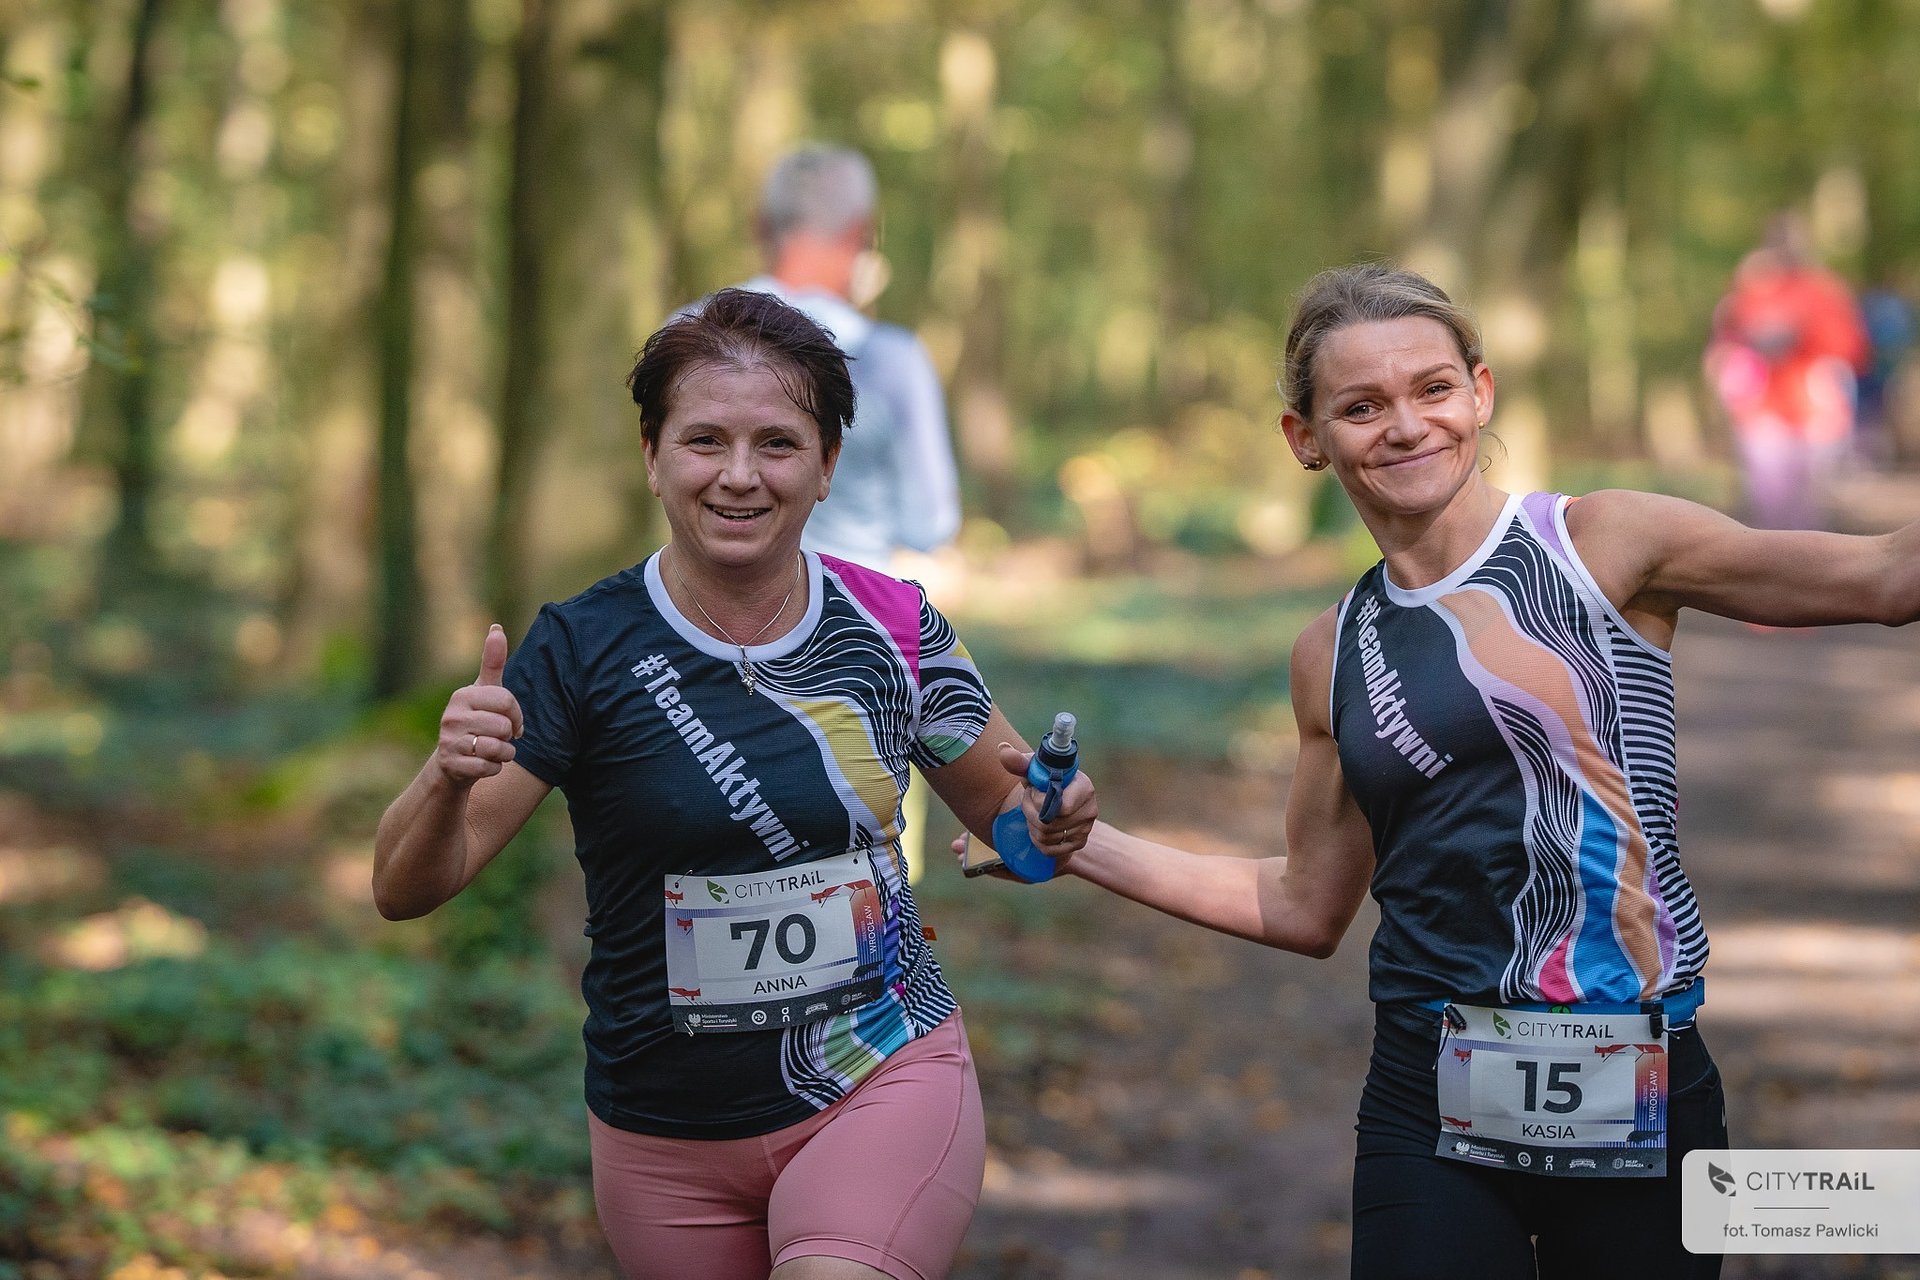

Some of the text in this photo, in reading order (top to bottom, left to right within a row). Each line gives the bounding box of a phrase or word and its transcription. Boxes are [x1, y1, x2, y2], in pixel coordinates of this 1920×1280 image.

[630, 653, 810, 863] #TeamAktywni
[729, 913, 817, 971] 70
[864, 905, 877, 954] WROCŁAW
[753, 975, 808, 995] ANNA
[1515, 1060, 1583, 1114] 15
[1649, 1070, 1658, 1121] WROCŁAW
[1522, 1123, 1576, 1139] KASIA
